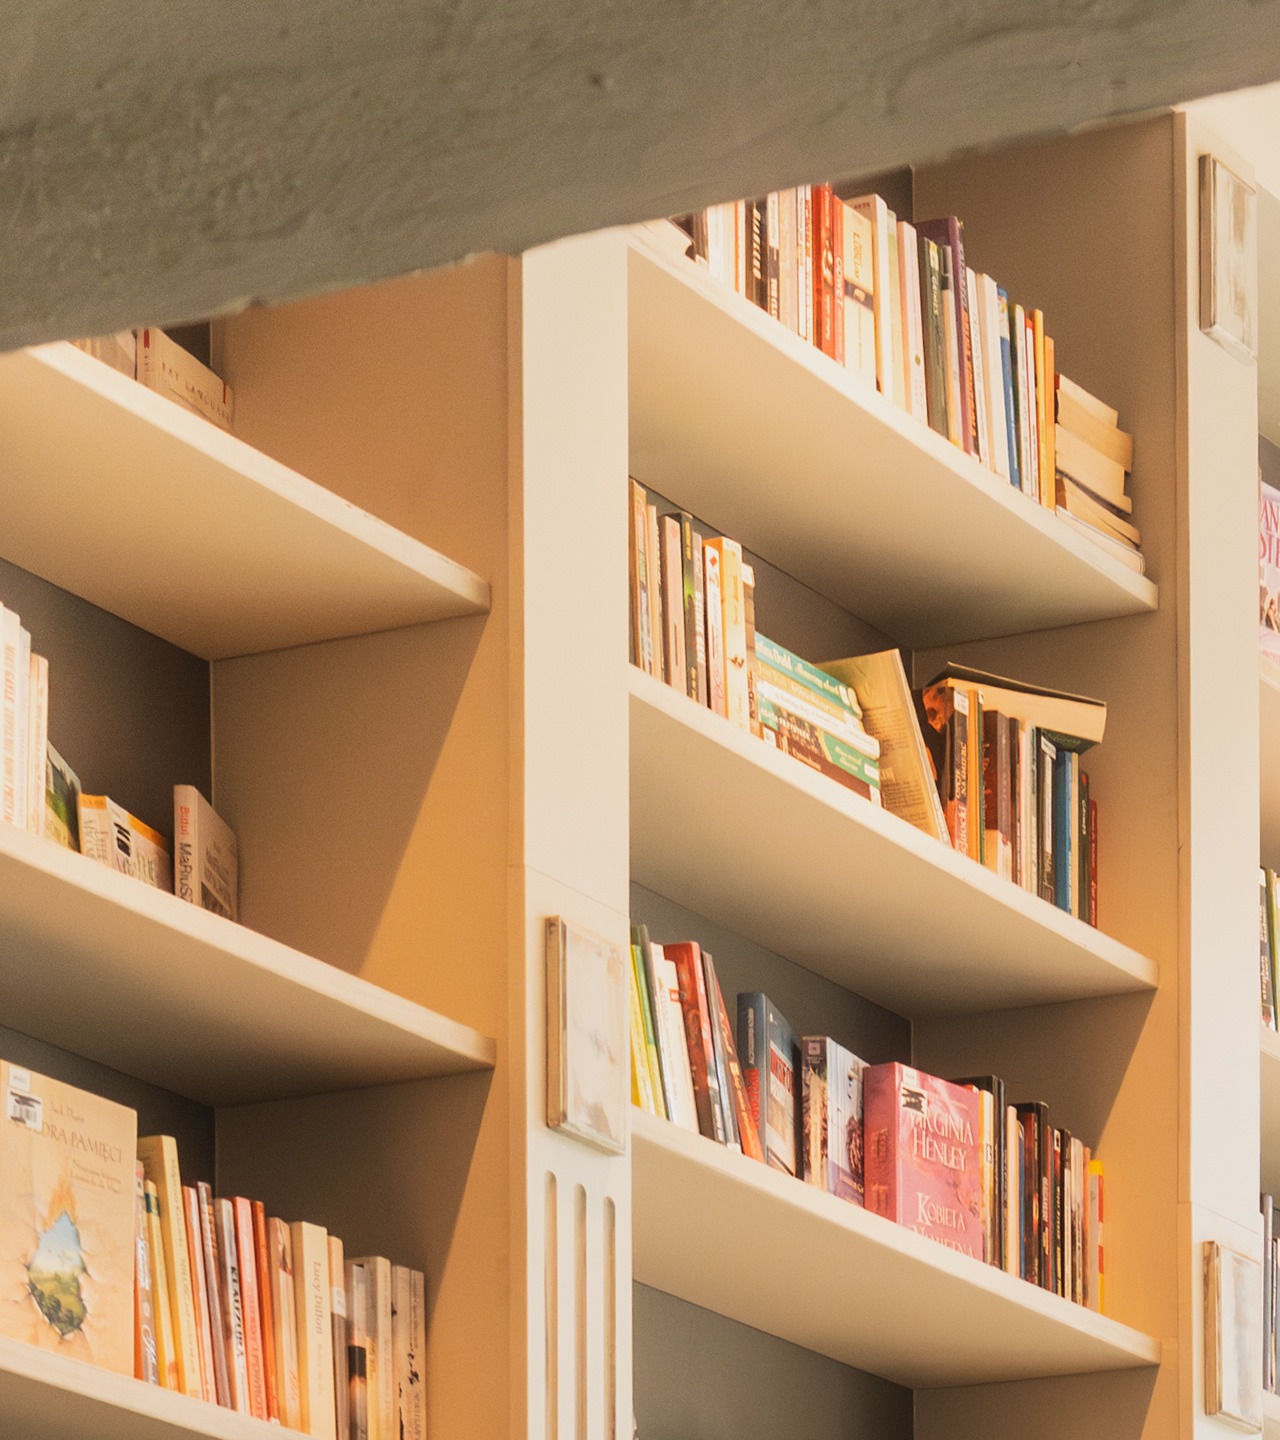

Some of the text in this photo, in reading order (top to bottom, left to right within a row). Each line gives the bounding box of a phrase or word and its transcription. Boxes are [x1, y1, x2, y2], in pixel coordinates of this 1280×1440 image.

[910, 1104, 974, 1147] VIRGINIA
[913, 1127, 967, 1172] HENLEY
[916, 1191, 966, 1232] KOBIETA
[312, 1261, 323, 1335] Lucy Dillon
